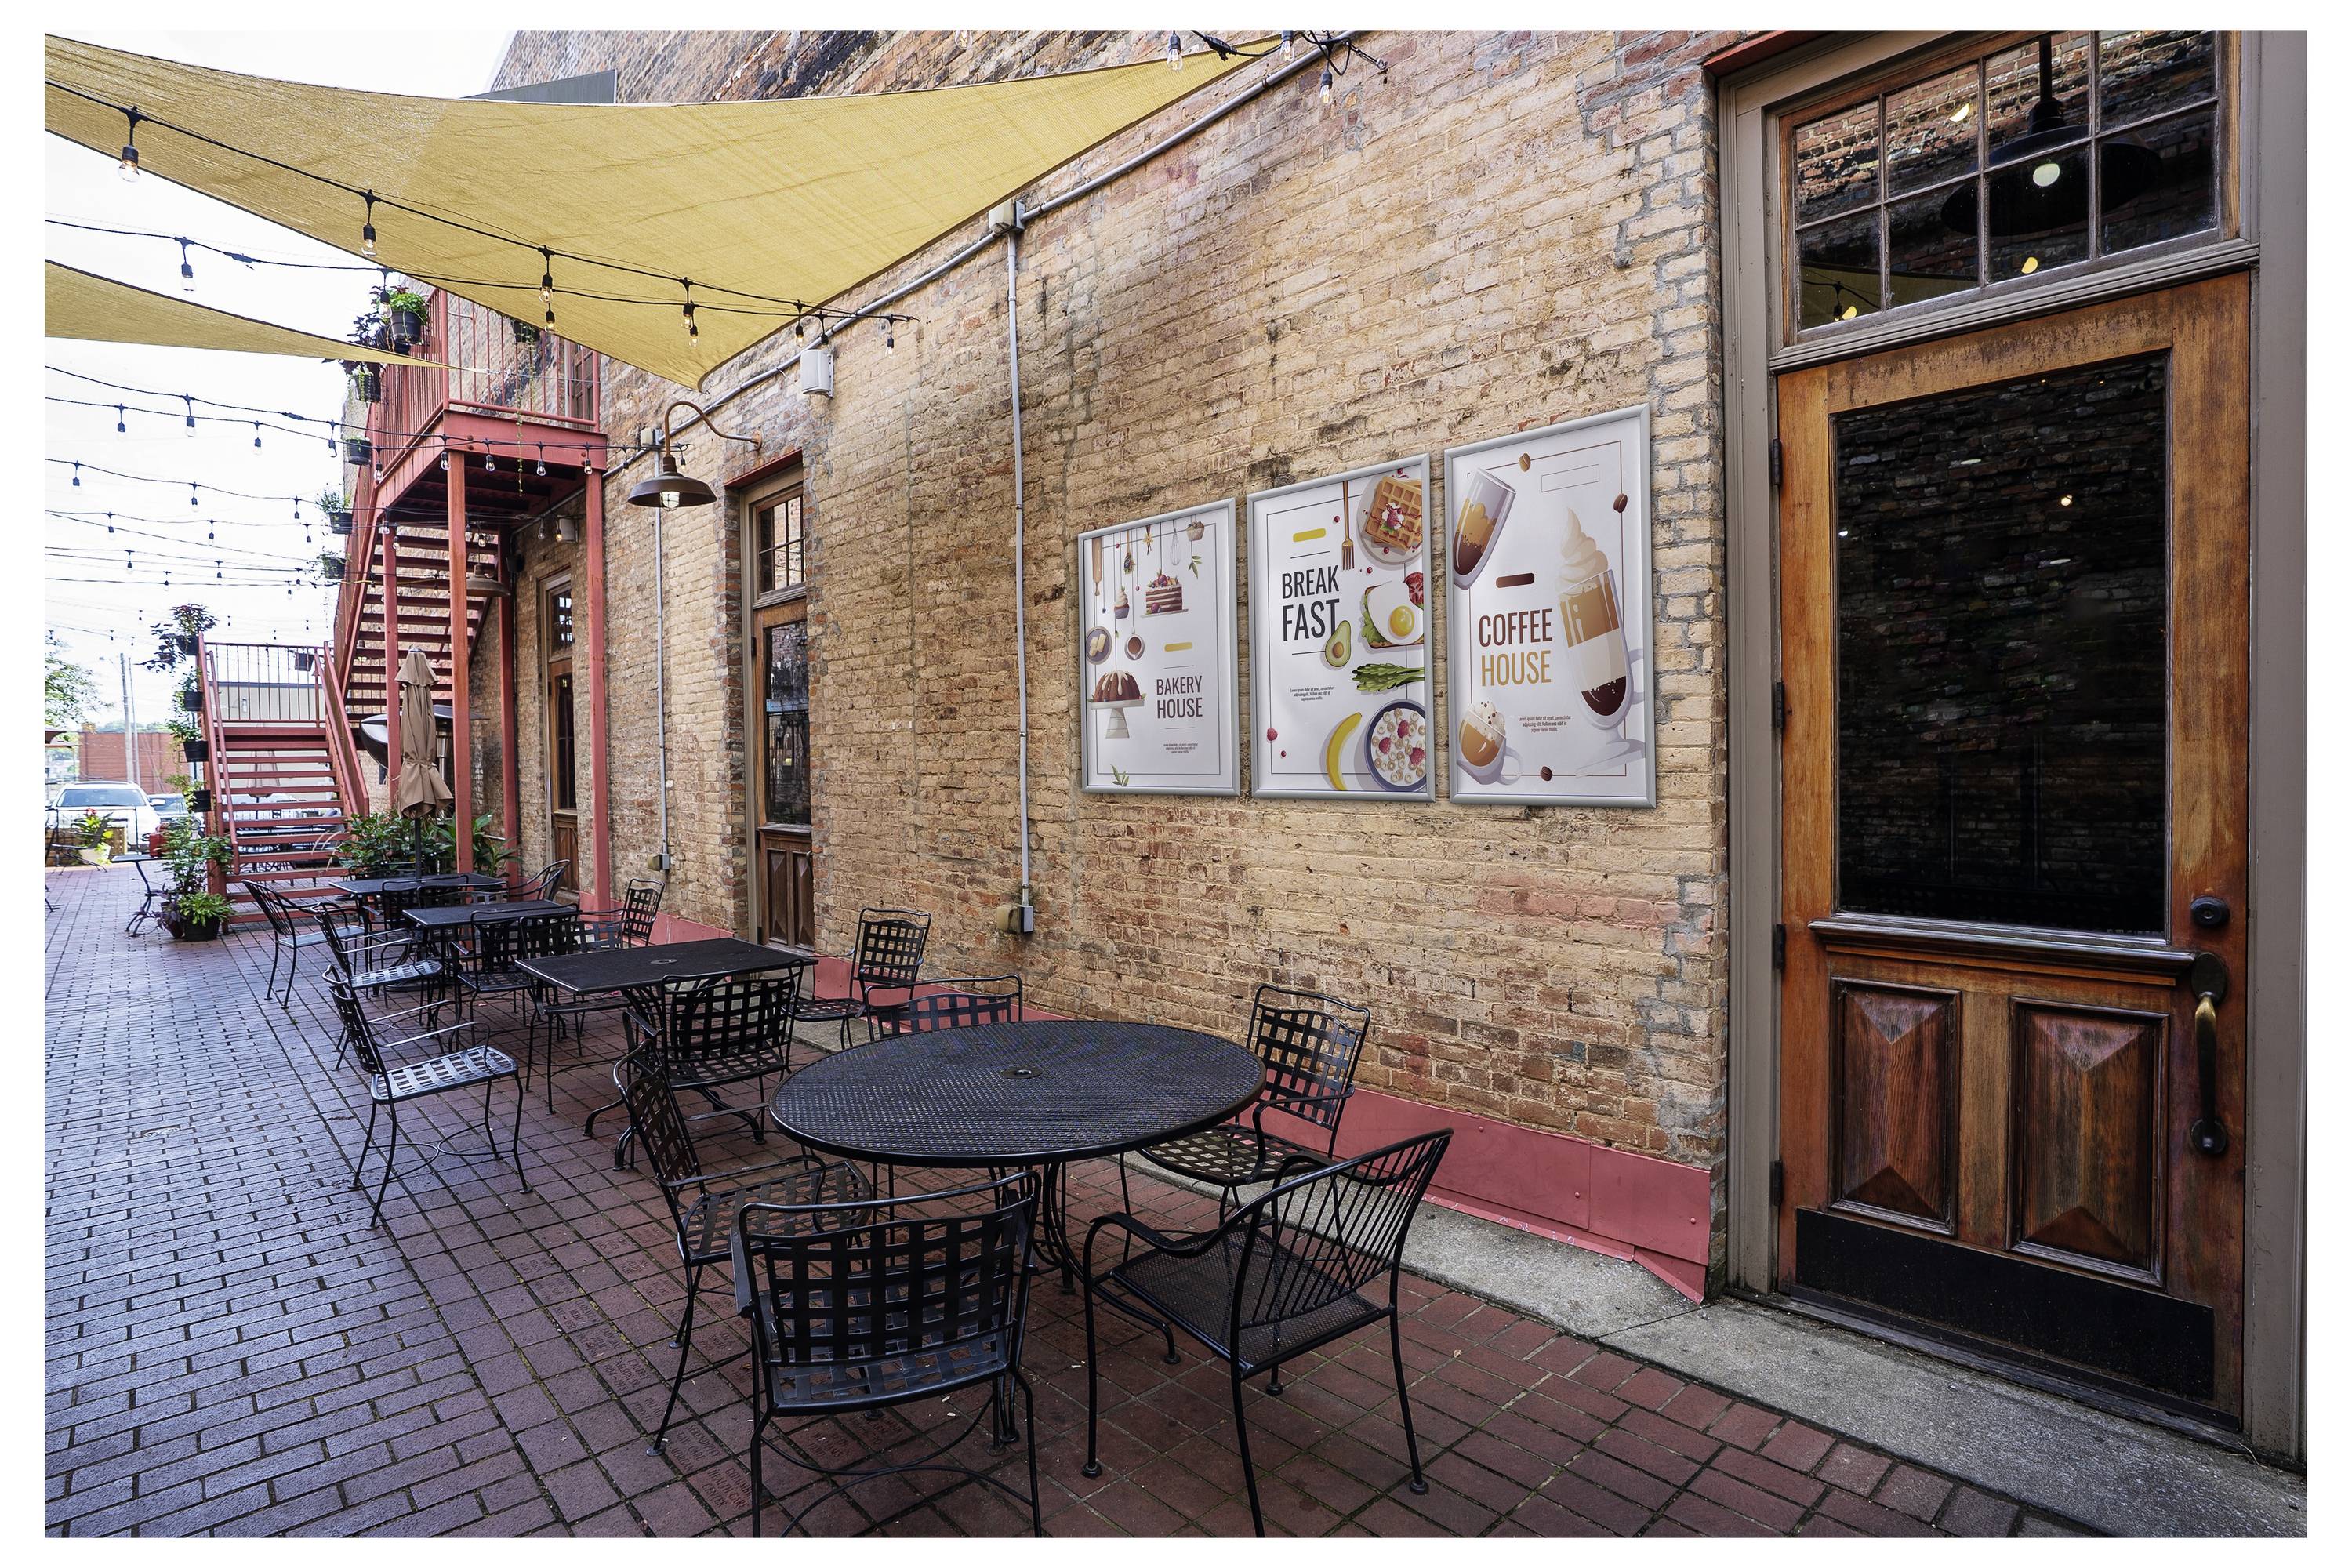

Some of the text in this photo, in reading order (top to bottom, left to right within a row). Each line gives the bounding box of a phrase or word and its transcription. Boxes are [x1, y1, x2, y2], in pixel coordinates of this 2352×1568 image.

[1282, 564, 1339, 599] BREAK
[1283, 598, 1340, 641] FAST
[1479, 608, 1552, 647] COFFEE
[1481, 650, 1552, 687] HOUSE
[1156, 675, 1202, 695] BAKERY
[1157, 697, 1203, 719] HOUSE
[699, 1482, 730, 1508] CENTER
[706, 1468, 737, 1493] HEALTH
